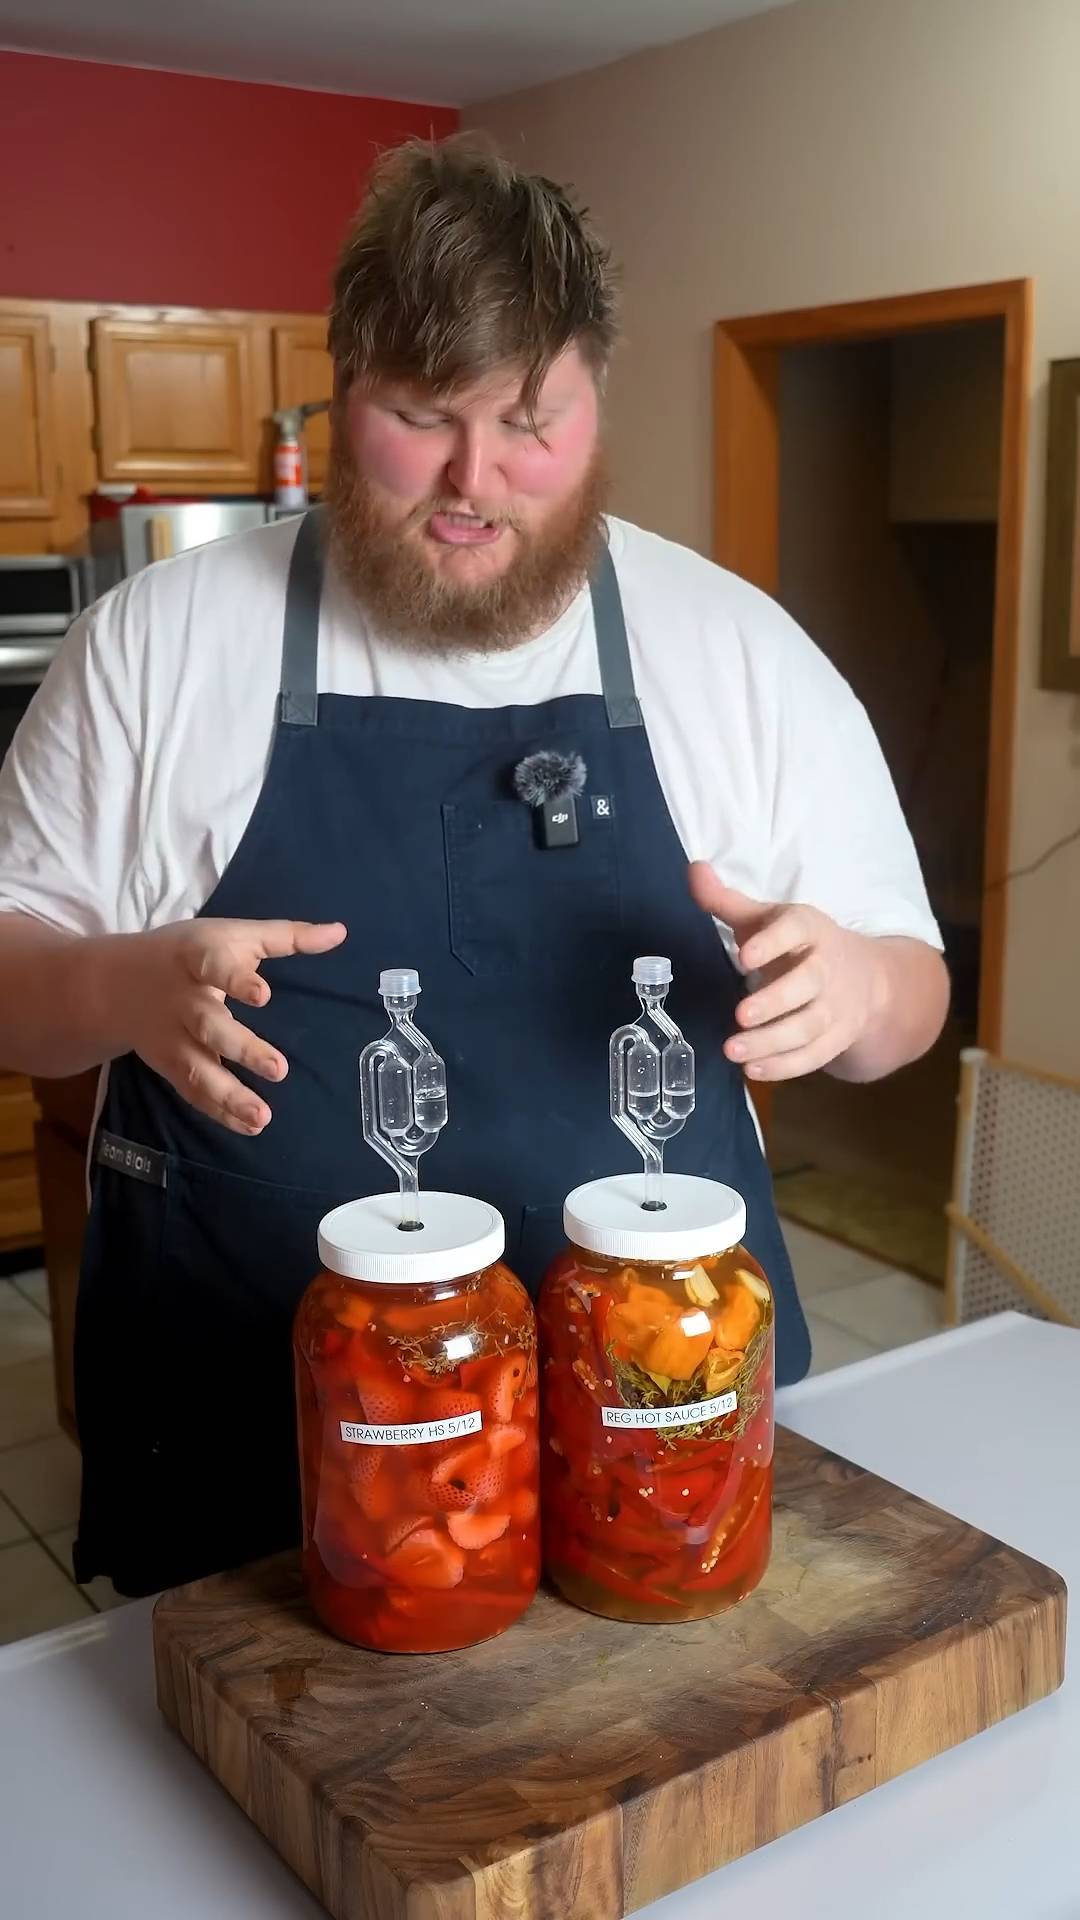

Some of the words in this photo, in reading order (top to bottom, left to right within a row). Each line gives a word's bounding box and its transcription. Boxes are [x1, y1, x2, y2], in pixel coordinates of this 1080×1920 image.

[596, 799, 610, 816] &
[606, 1411, 632, 1424] REG
[635, 1411, 662, 1424] HOT
[665, 1405, 708, 1423] SAUCE
[709, 1396, 733, 1415] 5/12
[345, 1426, 425, 1441] STRAWBERRY
[428, 1424, 445, 1438] HS
[448, 1417, 476, 1434] 5/12
